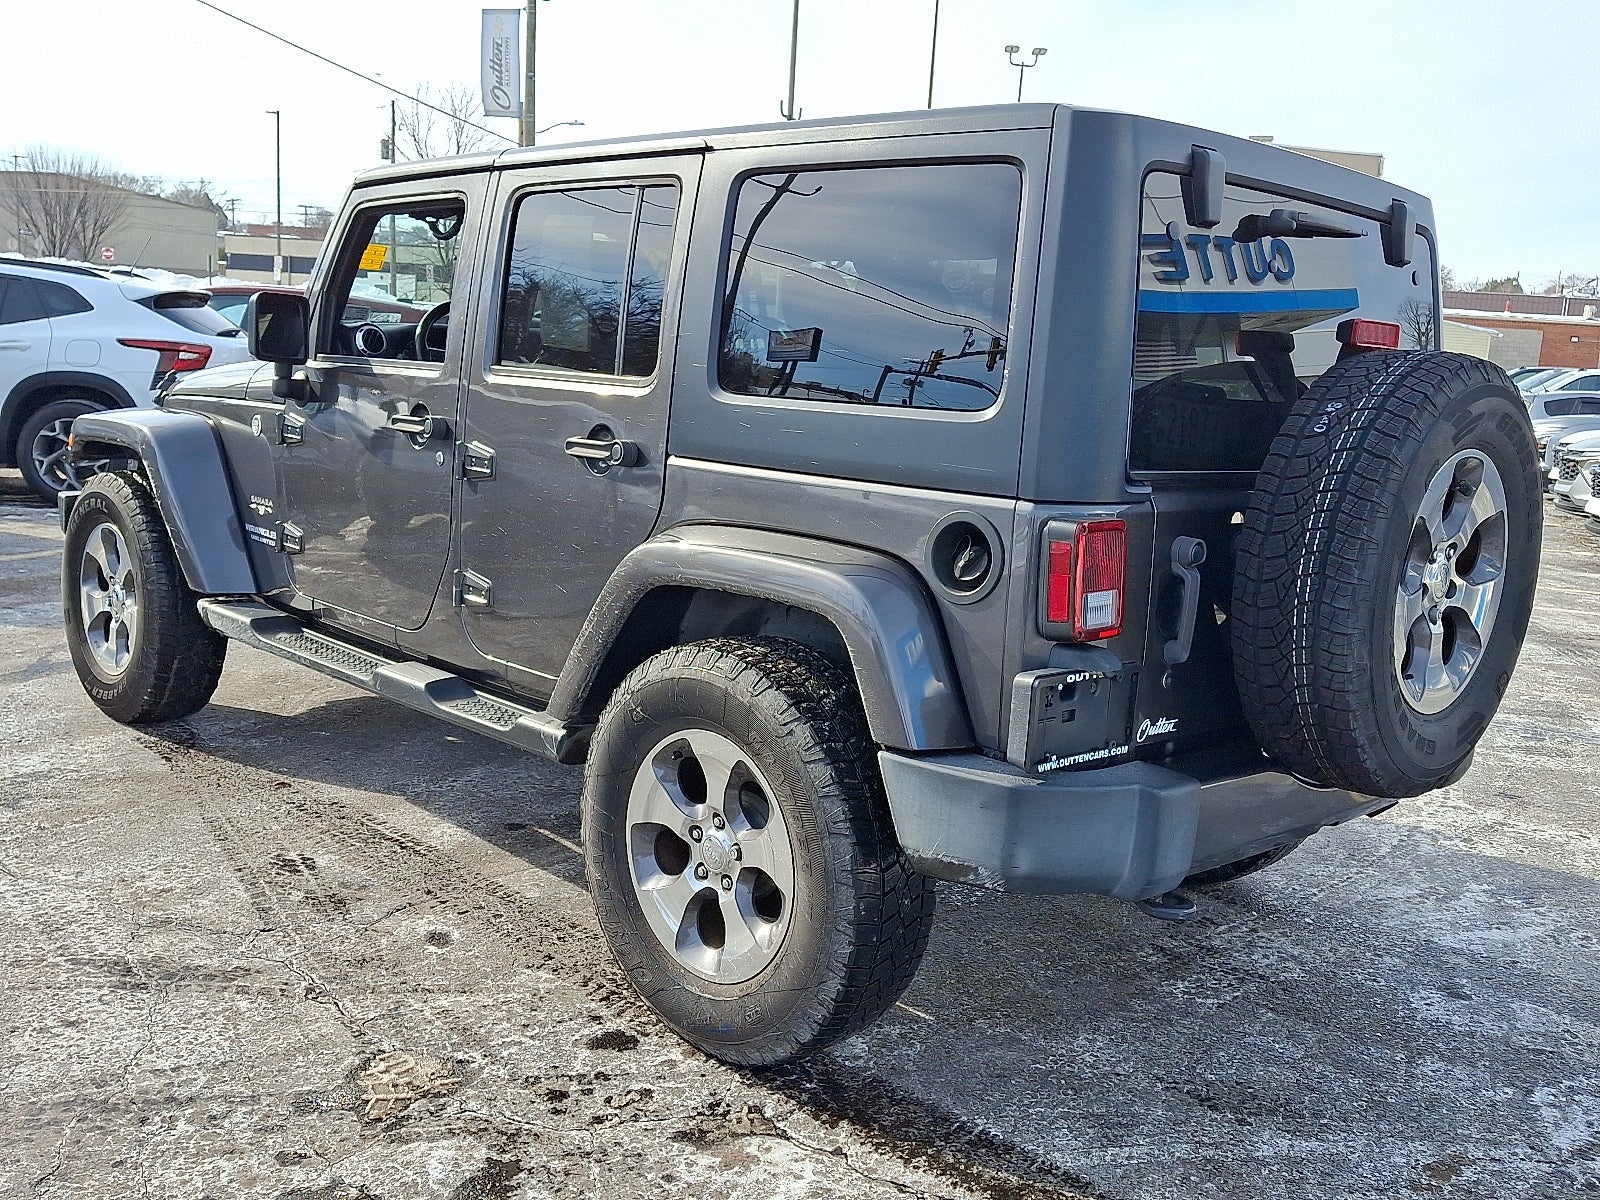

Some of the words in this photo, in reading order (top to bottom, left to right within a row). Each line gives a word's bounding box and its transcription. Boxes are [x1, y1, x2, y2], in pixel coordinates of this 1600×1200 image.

[489, 37, 511, 110] Outten
[503, 37, 511, 87] ALLENTOWN
[70, 497, 108, 532] GENERAL
[250, 495, 273, 507] SAHARA
[245, 523, 277, 539] WRANGLE
[91, 676, 127, 701] GRABBER
[1136, 717, 1179, 742] Outten
[1037, 745, 1129, 774] WWW.OUTTENCARS.COM
